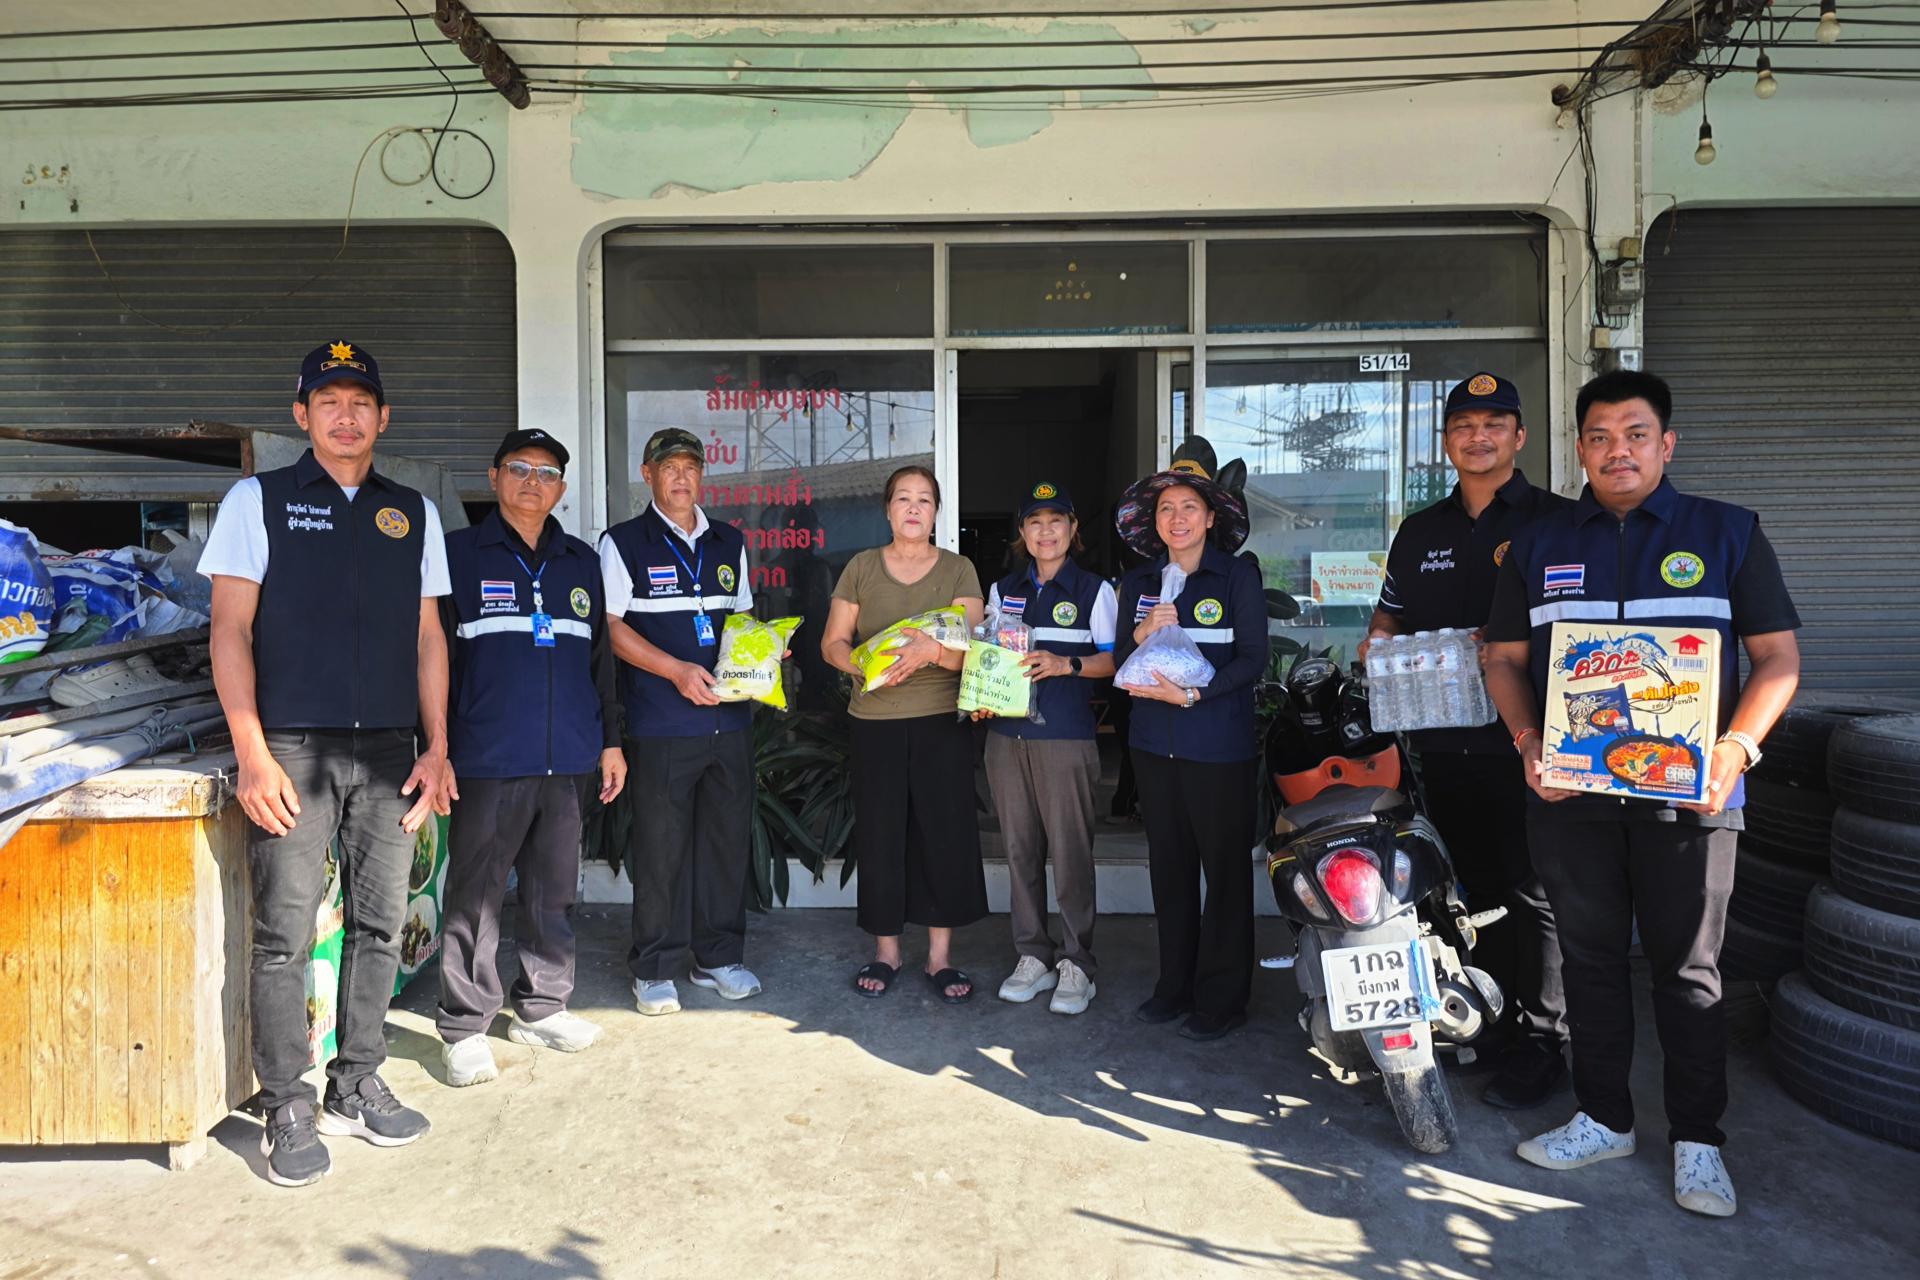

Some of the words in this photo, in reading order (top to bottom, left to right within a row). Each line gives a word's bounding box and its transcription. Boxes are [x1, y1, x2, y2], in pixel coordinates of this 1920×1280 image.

[1360, 354, 1409, 370] 51/14
[706, 374, 841, 422] ส้มตำบุษบา
[728, 518, 825, 549] ้าวกล่อง
[1328, 578, 1375, 591] จำนวนมาก
[1326, 837, 1357, 849] HONDA
[1358, 978, 1400, 996] บึงกาฬ
[1344, 996, 1421, 1023] 5728
